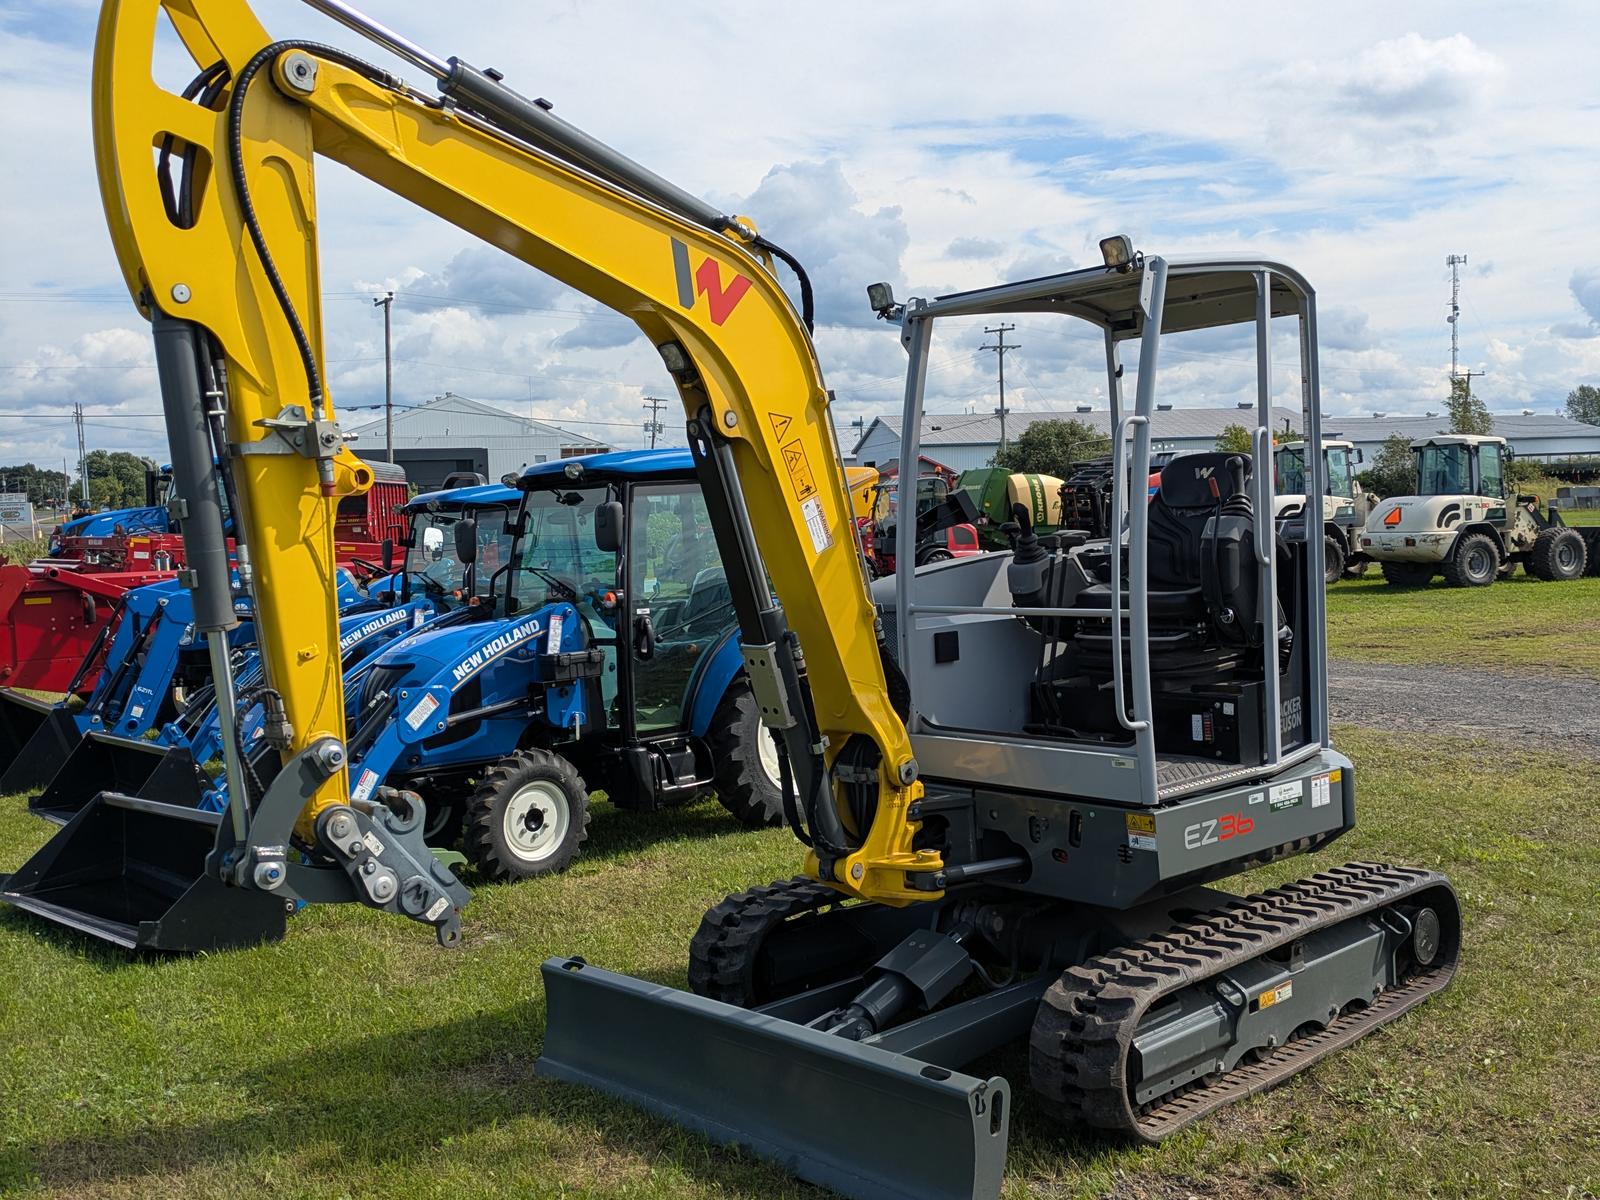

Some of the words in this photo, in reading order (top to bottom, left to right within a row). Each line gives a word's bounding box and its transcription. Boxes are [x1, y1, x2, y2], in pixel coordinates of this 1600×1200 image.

[1032, 478, 1044, 512] KRONE
[340, 629, 363, 649] NEW
[362, 609, 407, 635] HOLLAND
[452, 650, 484, 681] NEW
[482, 619, 540, 659] HOLLAND
[1280, 696, 1302, 717] ACKER
[1280, 711, 1302, 733] EUSON
[1184, 811, 1256, 850] EZ36
